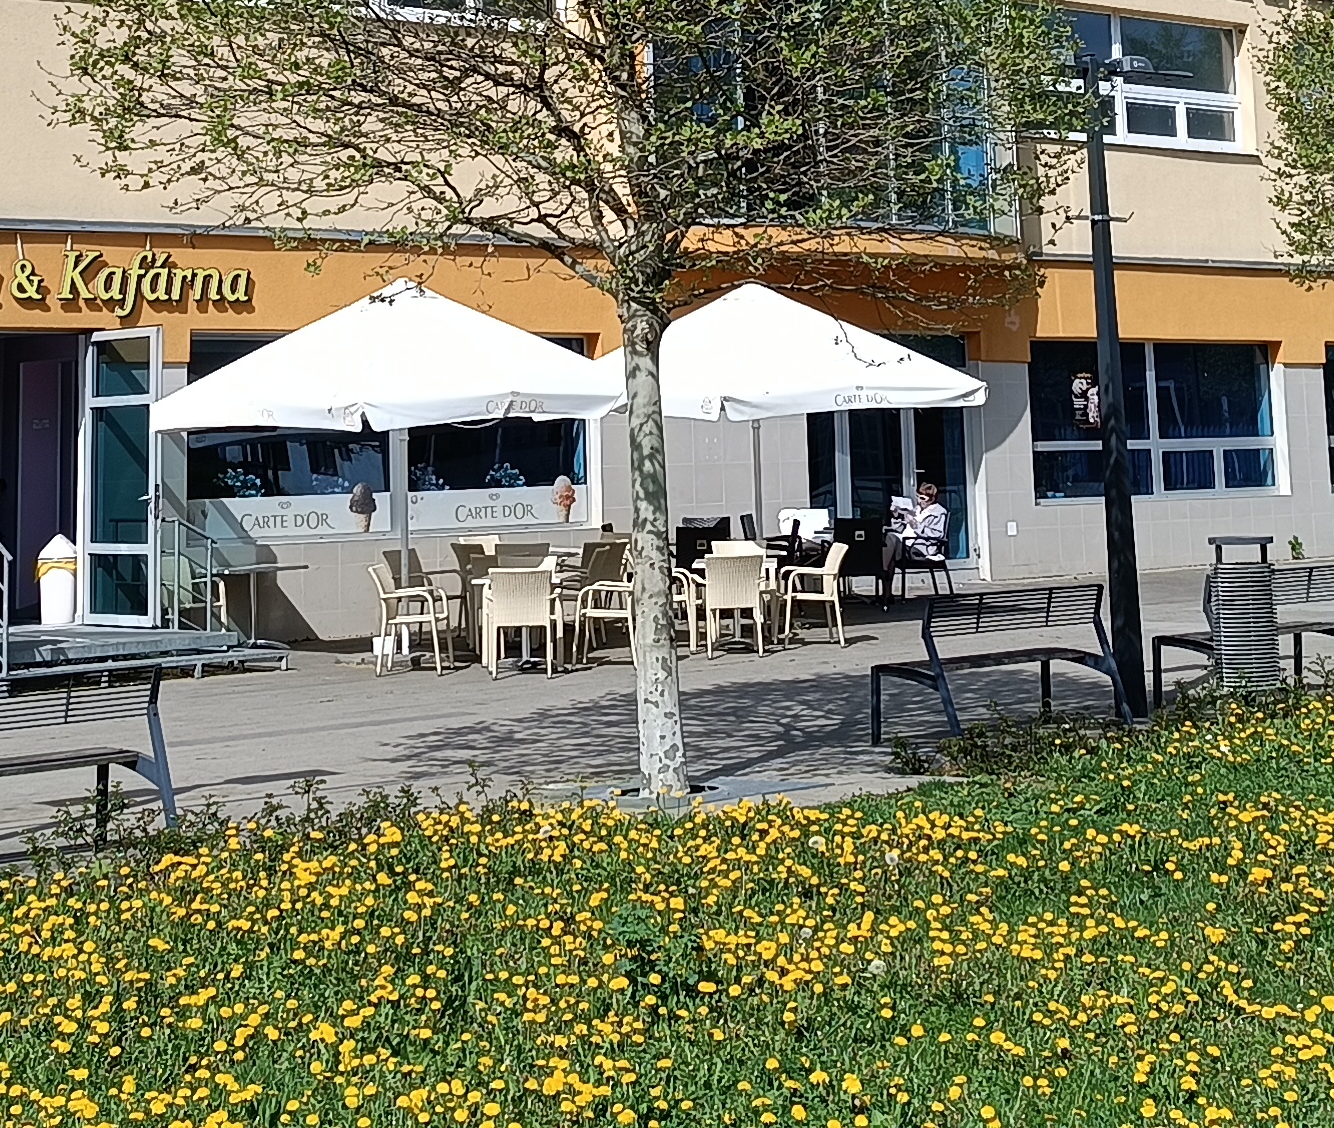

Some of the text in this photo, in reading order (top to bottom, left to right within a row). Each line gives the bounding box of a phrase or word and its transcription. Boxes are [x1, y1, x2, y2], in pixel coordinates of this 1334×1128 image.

[9, 258, 43, 301] &
[56, 249, 251, 319] Kafárna
[485, 400, 517, 415] CARTE
[834, 394, 863, 406] CARTE
[239, 511, 335, 532] CARTE D'OR
[455, 502, 539, 522] CARTE D'OR
